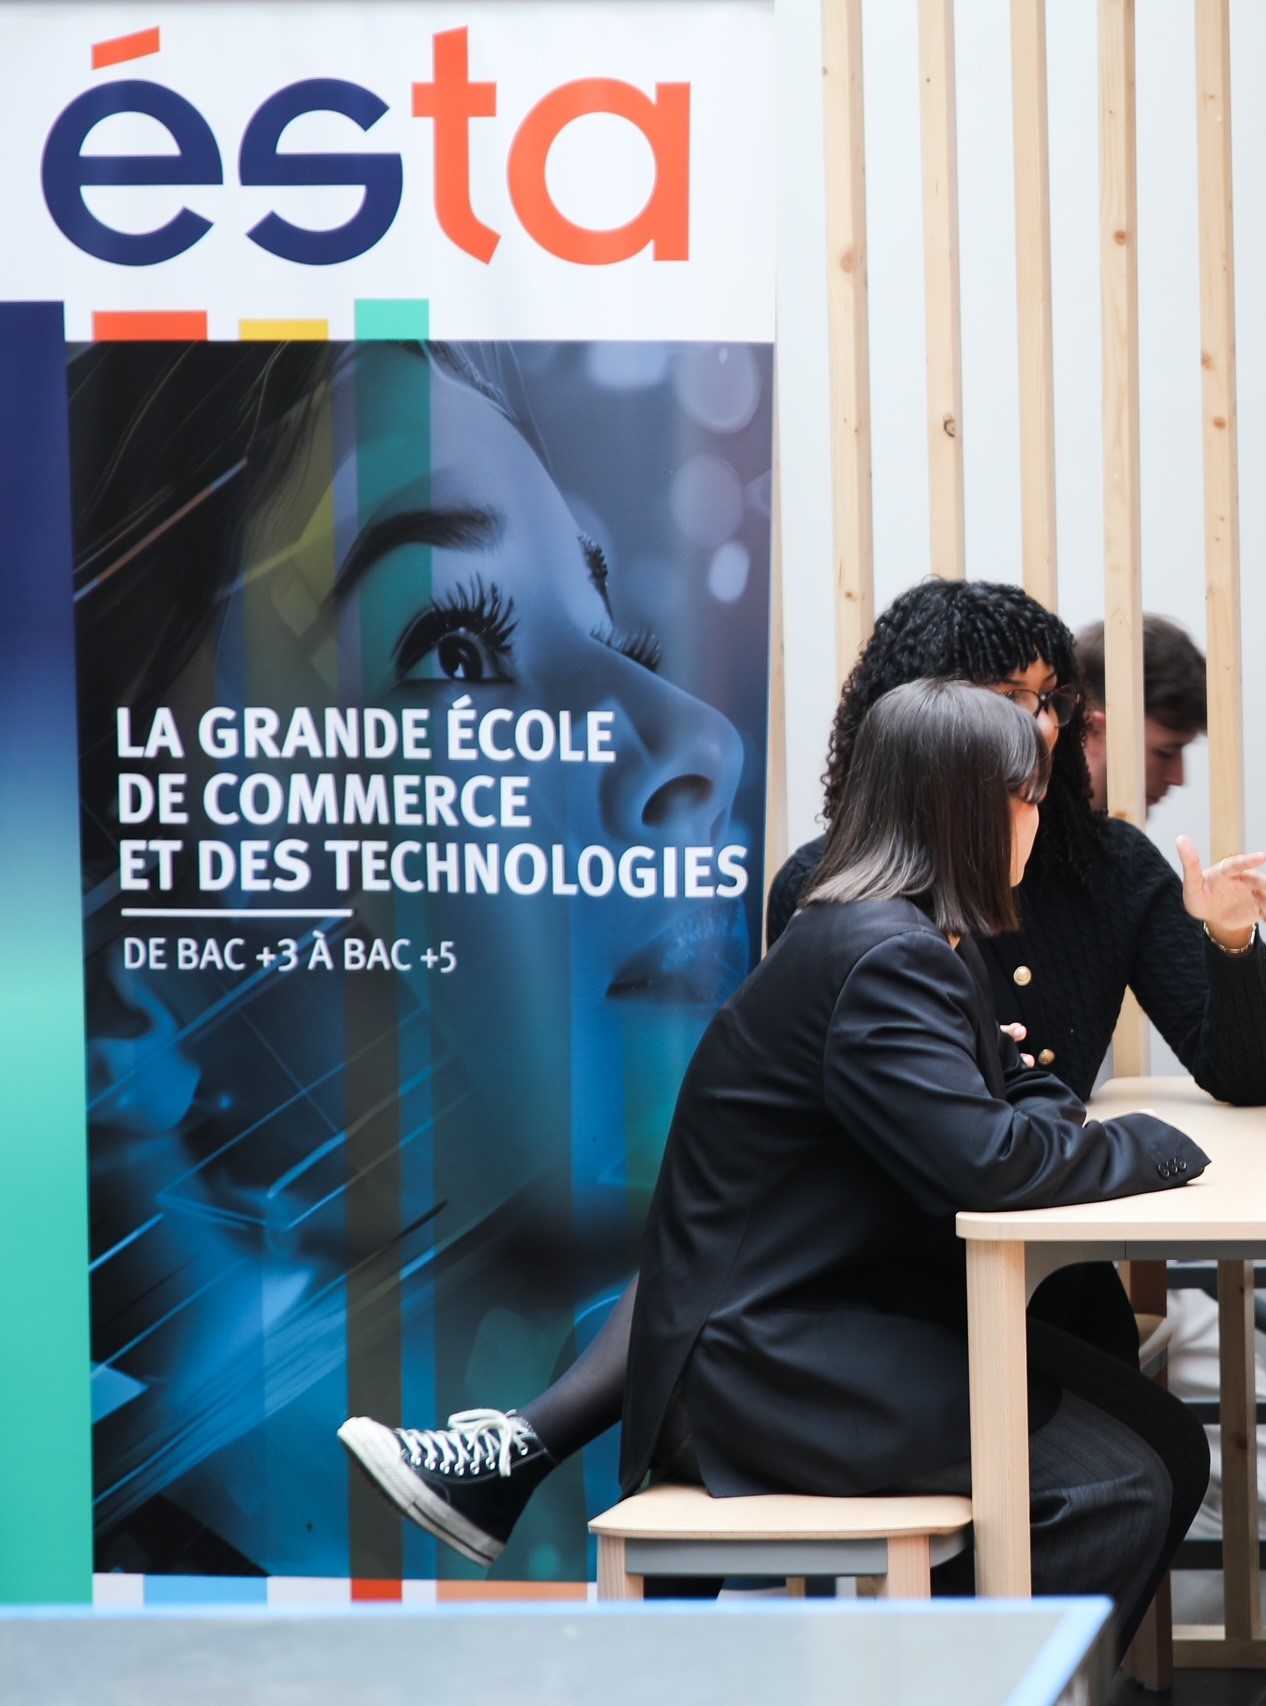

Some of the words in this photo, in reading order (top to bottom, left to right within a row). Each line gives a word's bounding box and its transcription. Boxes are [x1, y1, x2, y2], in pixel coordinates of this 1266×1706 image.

[40, 25, 692, 266] ésta
[116, 706, 184, 759] LA
[198, 706, 431, 761] GRANDE
[446, 695, 617, 763] ÉCOLE
[118, 773, 188, 824] DE
[202, 773, 532, 828] COMMERCE
[119, 839, 183, 891] ET
[199, 839, 312, 892] DES
[324, 840, 749, 899] TECHNOLOGIES
[123, 937, 168, 970] DE
[177, 937, 245, 971] BAC
[255, 938, 299, 972] +3
[307, 930, 335, 971] À
[343, 938, 412, 972] BAC
[420, 940, 457, 973] +5
